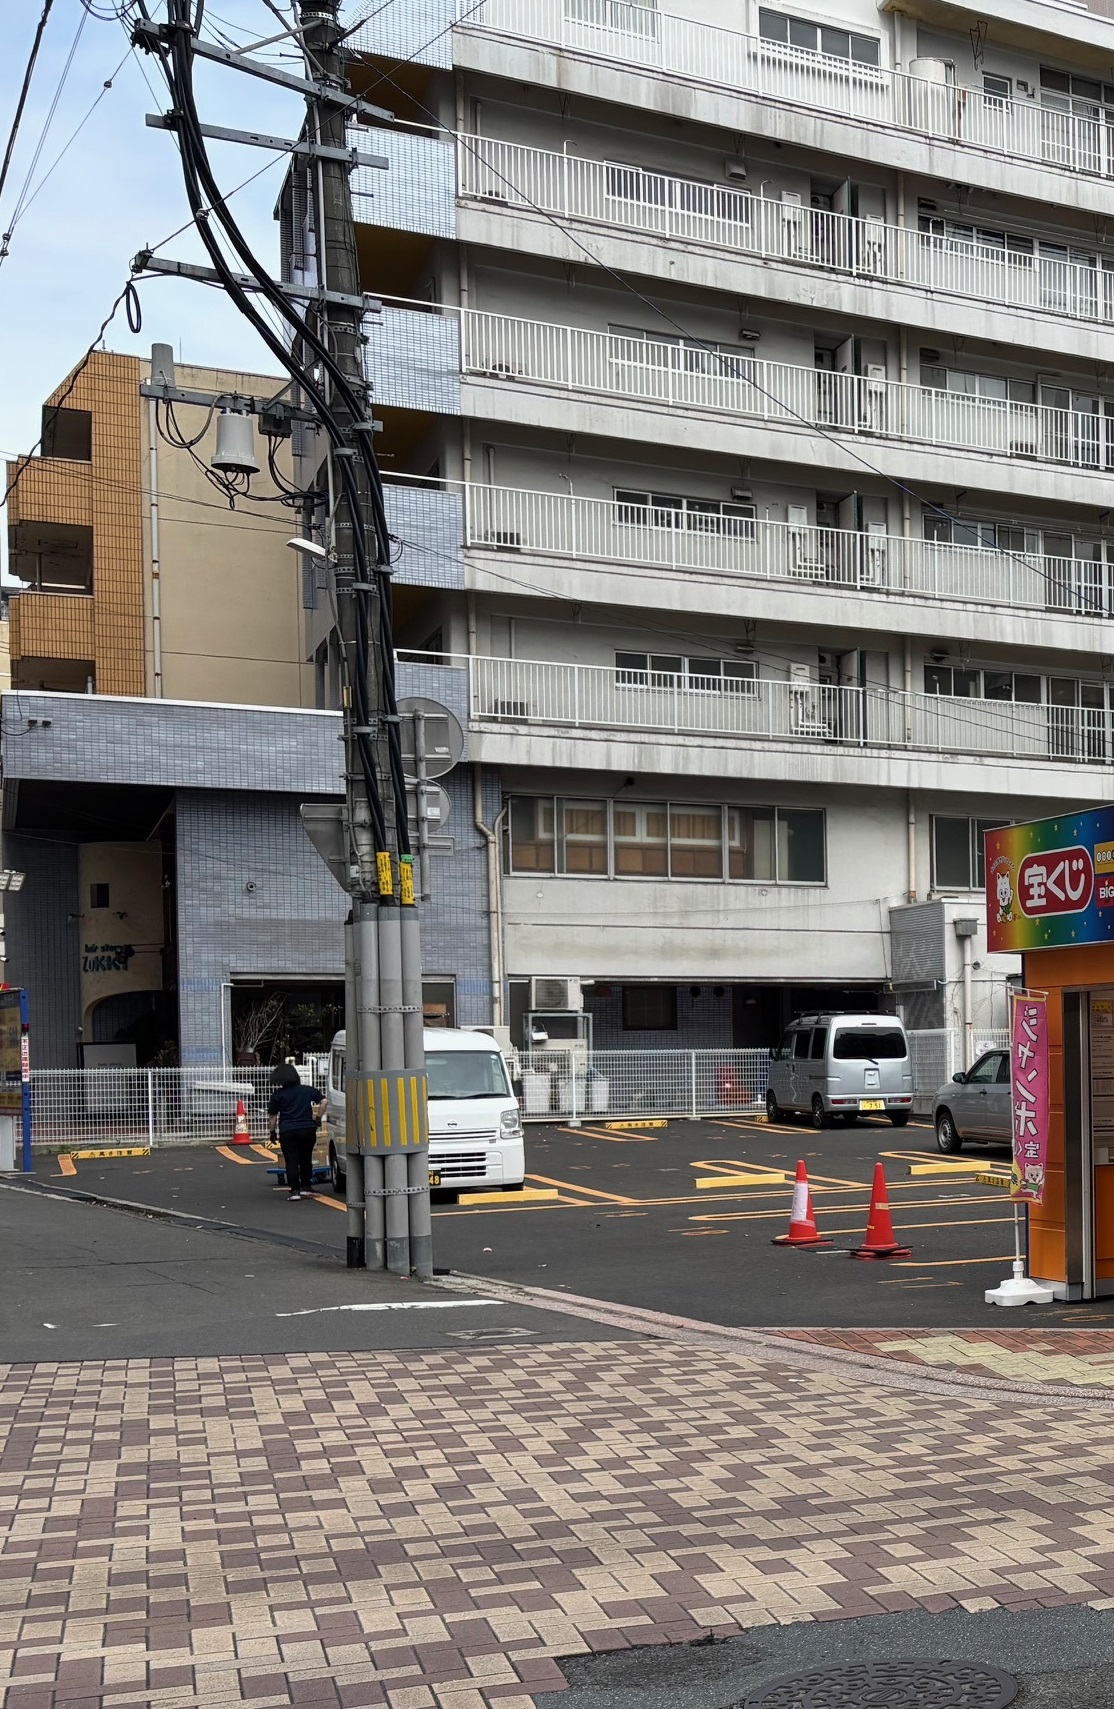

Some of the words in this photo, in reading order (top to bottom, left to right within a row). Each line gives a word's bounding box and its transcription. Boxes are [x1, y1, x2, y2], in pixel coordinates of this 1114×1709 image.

[1024, 858, 1086, 908] 宝くじ
[1099, 885, 1114, 899] BIG
